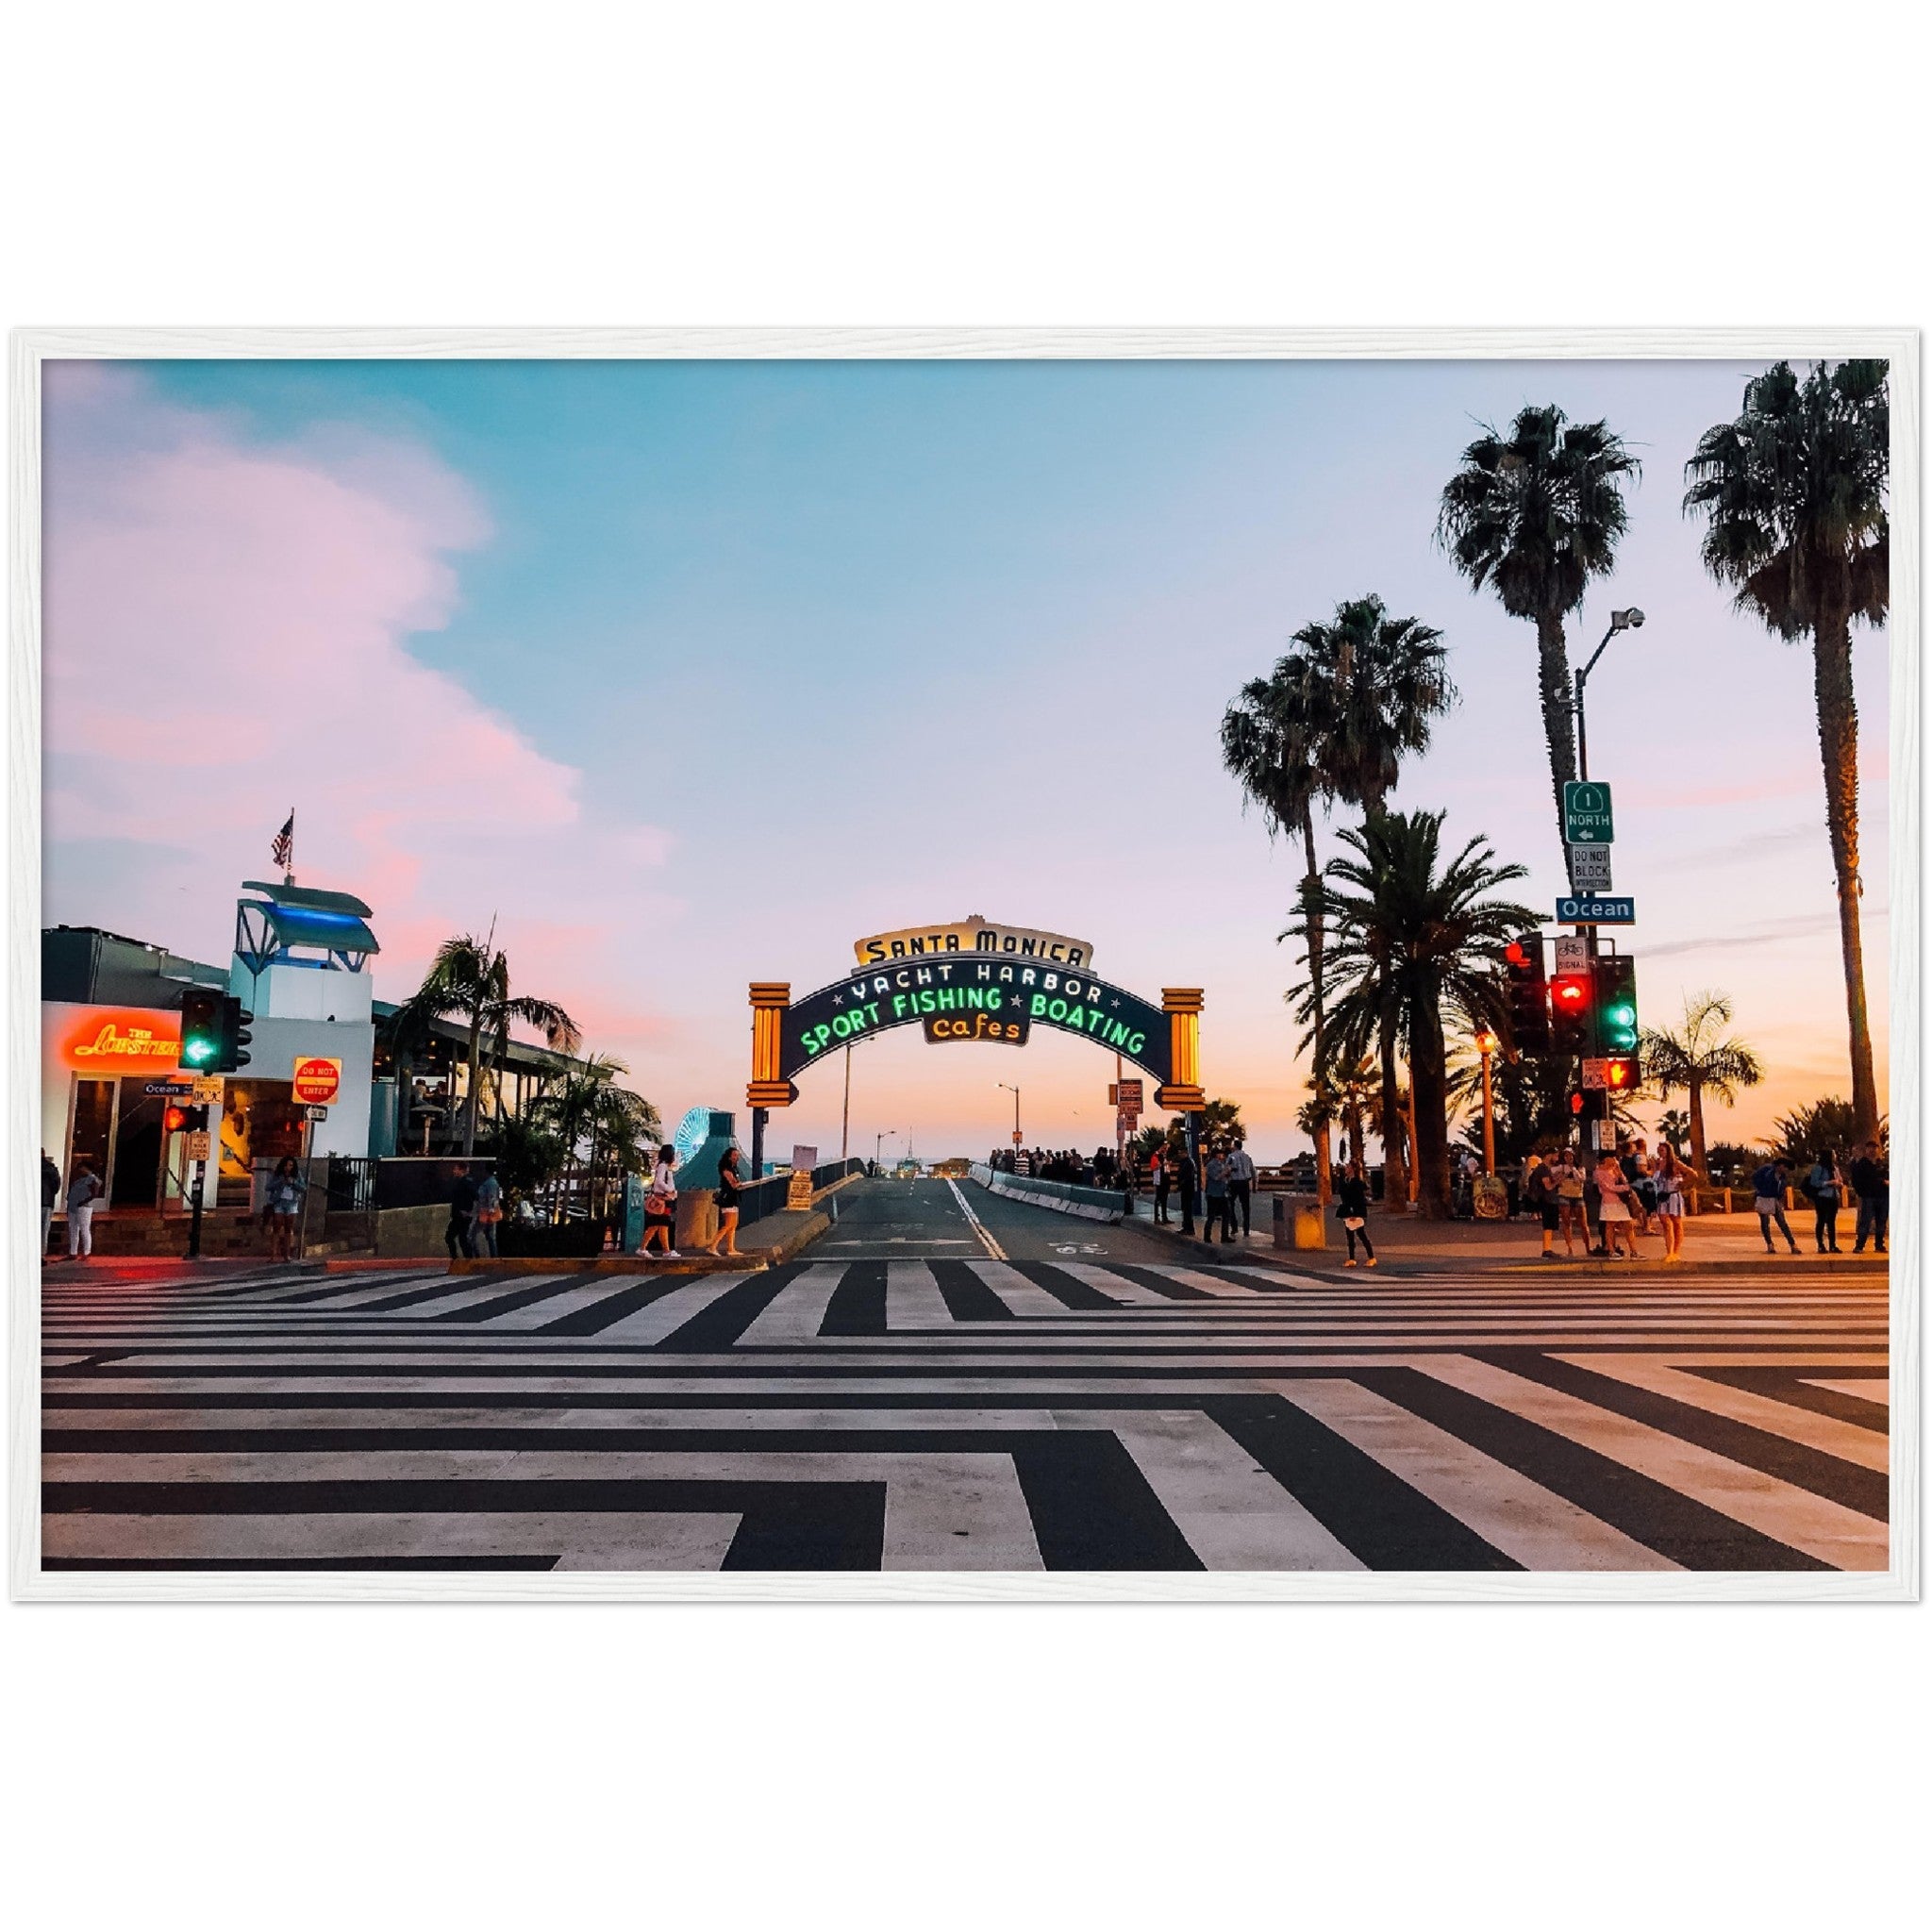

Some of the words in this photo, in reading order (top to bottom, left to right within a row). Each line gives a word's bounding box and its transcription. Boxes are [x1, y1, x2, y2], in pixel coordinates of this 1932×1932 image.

[1585, 792, 1591, 807] 1
[1569, 814, 1609, 826] NORTH
[1574, 851, 1587, 861] DO
[1590, 851, 1607, 861] NOT
[1575, 866, 1609, 876] BLOCK
[1562, 900, 1629, 917] Ocean
[866, 933, 959, 964] SANTA
[975, 930, 1083, 968] MONICA
[851, 964, 953, 1000] YACHT
[976, 964, 1102, 1005] HARBOR
[800, 1001, 879, 1055] SPORT
[891, 987, 1004, 1019] FISHING
[1029, 993, 1146, 1055] BOATING
[128, 1027, 153, 1040] THE
[302, 1067, 314, 1075] DO
[317, 1067, 335, 1075] NOT
[145, 1084, 179, 1093] Ocean
[303, 1086, 329, 1094] ENTER
